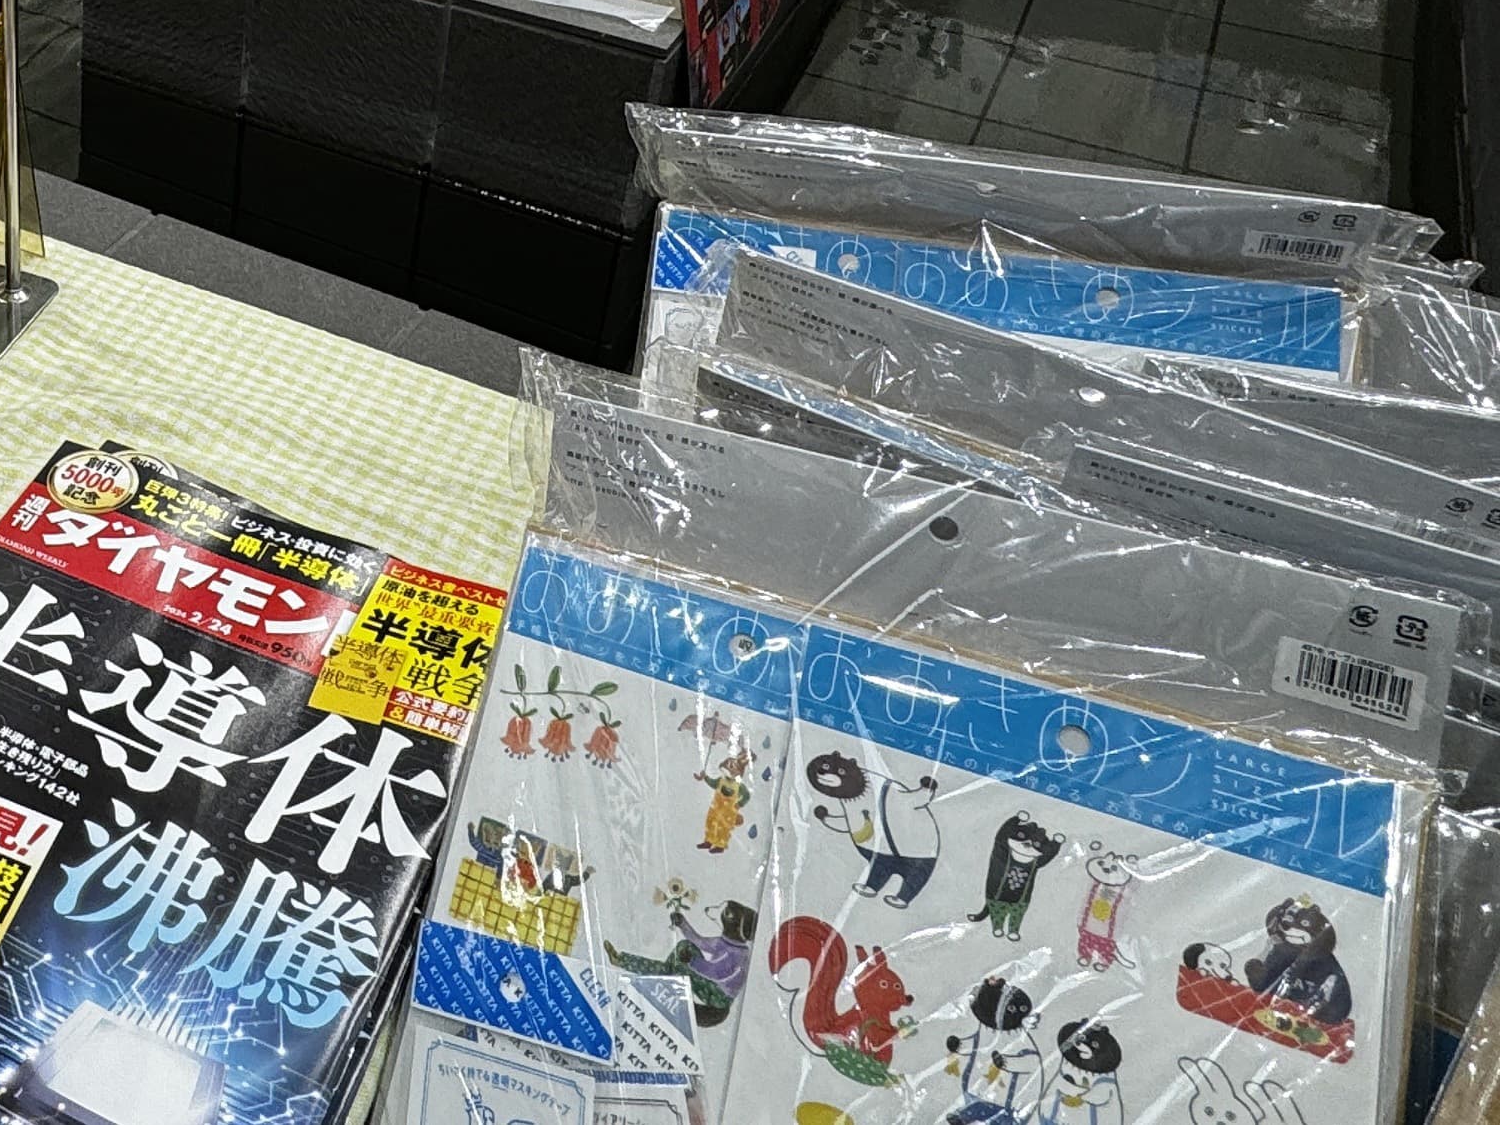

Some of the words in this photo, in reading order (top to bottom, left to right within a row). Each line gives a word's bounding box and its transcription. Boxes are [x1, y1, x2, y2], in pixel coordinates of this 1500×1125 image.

[85, 456, 124, 477] 創刊
[63, 482, 102, 506] 記念
[9, 491, 48, 532] 週刊
[130, 493, 372, 598] 丸ごと一冊「半導体」
[230, 513, 380, 575] ビジネス・投資に効く
[381, 579, 480, 616] 原油を超える
[191, 610, 234, 638] 2/24
[402, 657, 484, 706] 戦争
[50, 797, 382, 1033] 沸騰
[432, 937, 453, 970] KITTA
[429, 965, 450, 998] KITTA
[452, 971, 474, 1004] KITTA
[523, 962, 548, 995] KITTA
[549, 968, 573, 1003] KITTA
[617, 989, 646, 1023] KITTA
